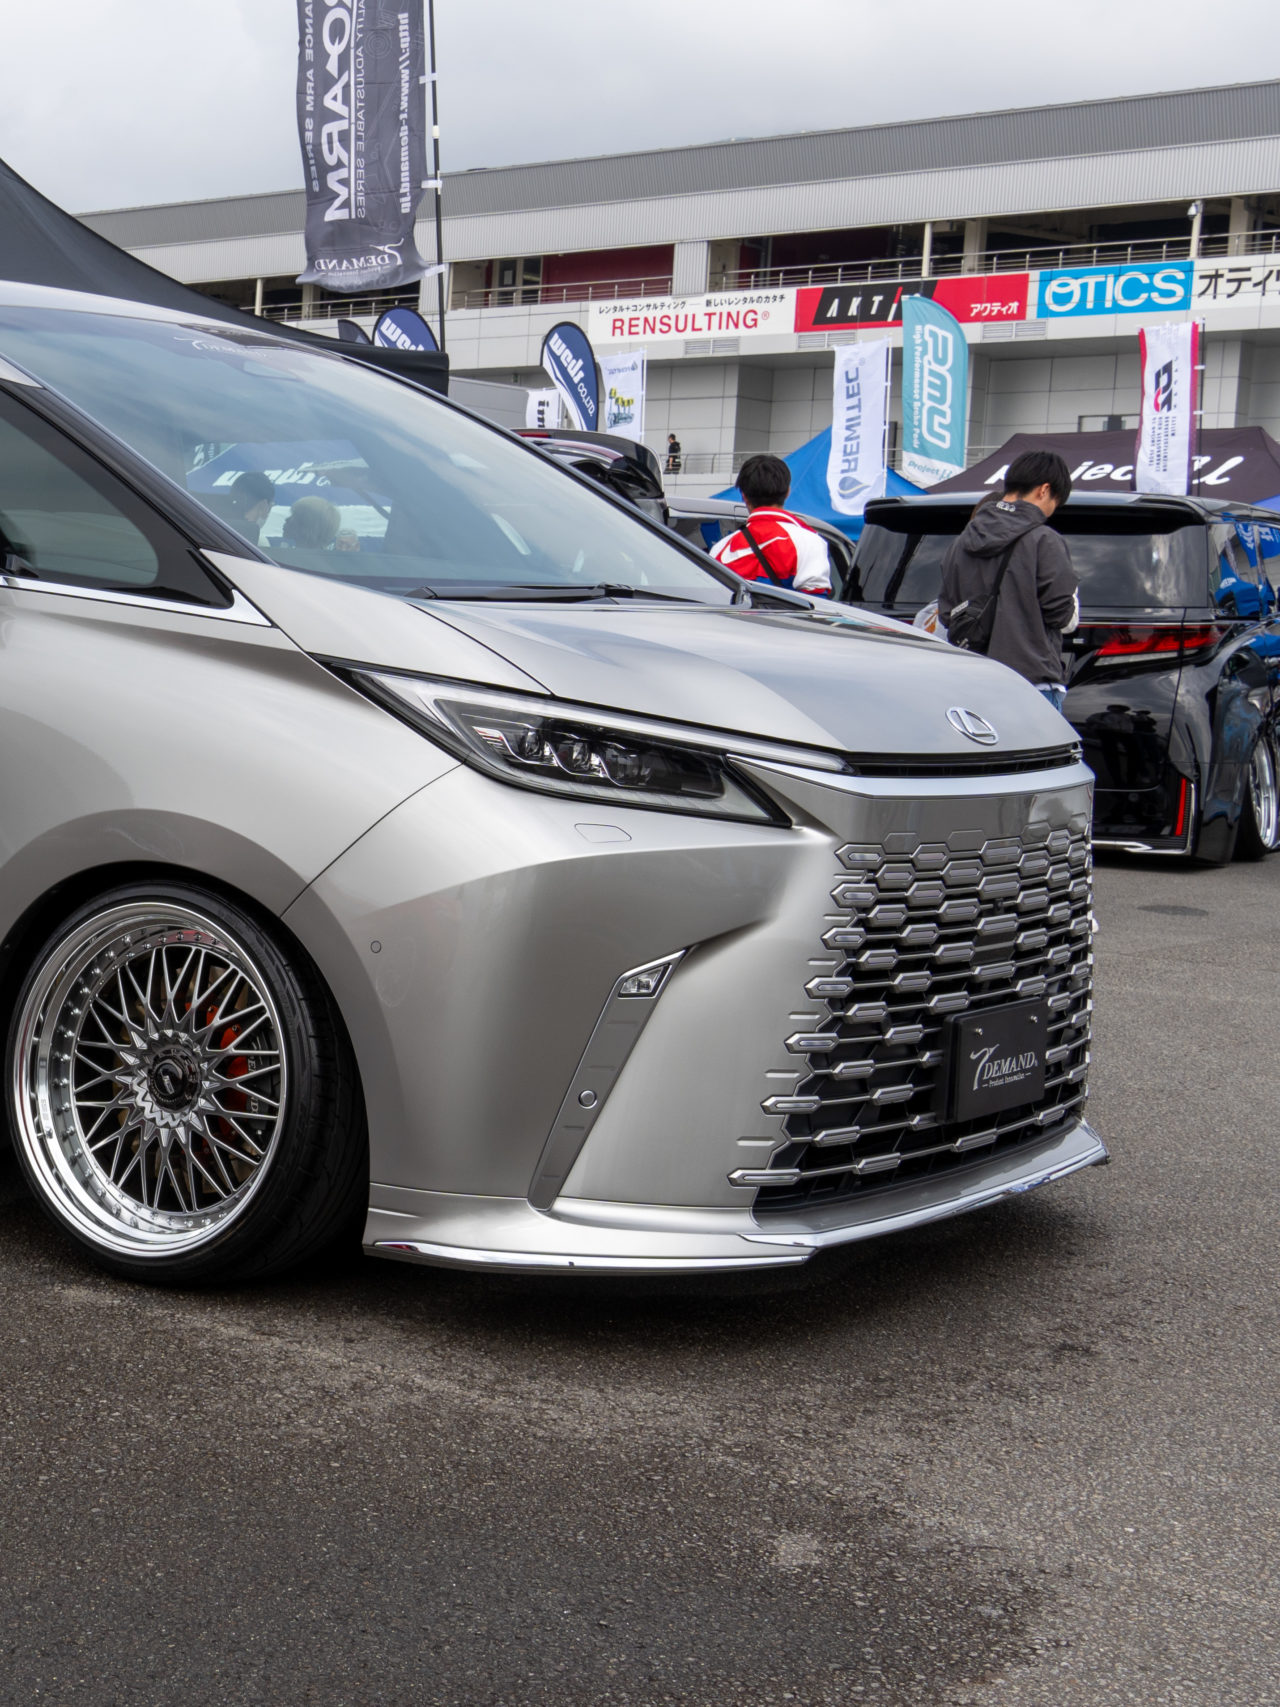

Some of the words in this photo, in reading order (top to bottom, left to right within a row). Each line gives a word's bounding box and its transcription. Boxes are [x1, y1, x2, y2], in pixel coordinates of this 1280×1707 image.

[970, 301, 1019, 317] アクティオ
[1044, 268, 1186, 312] OTICS
[548, 332, 585, 385] weds
